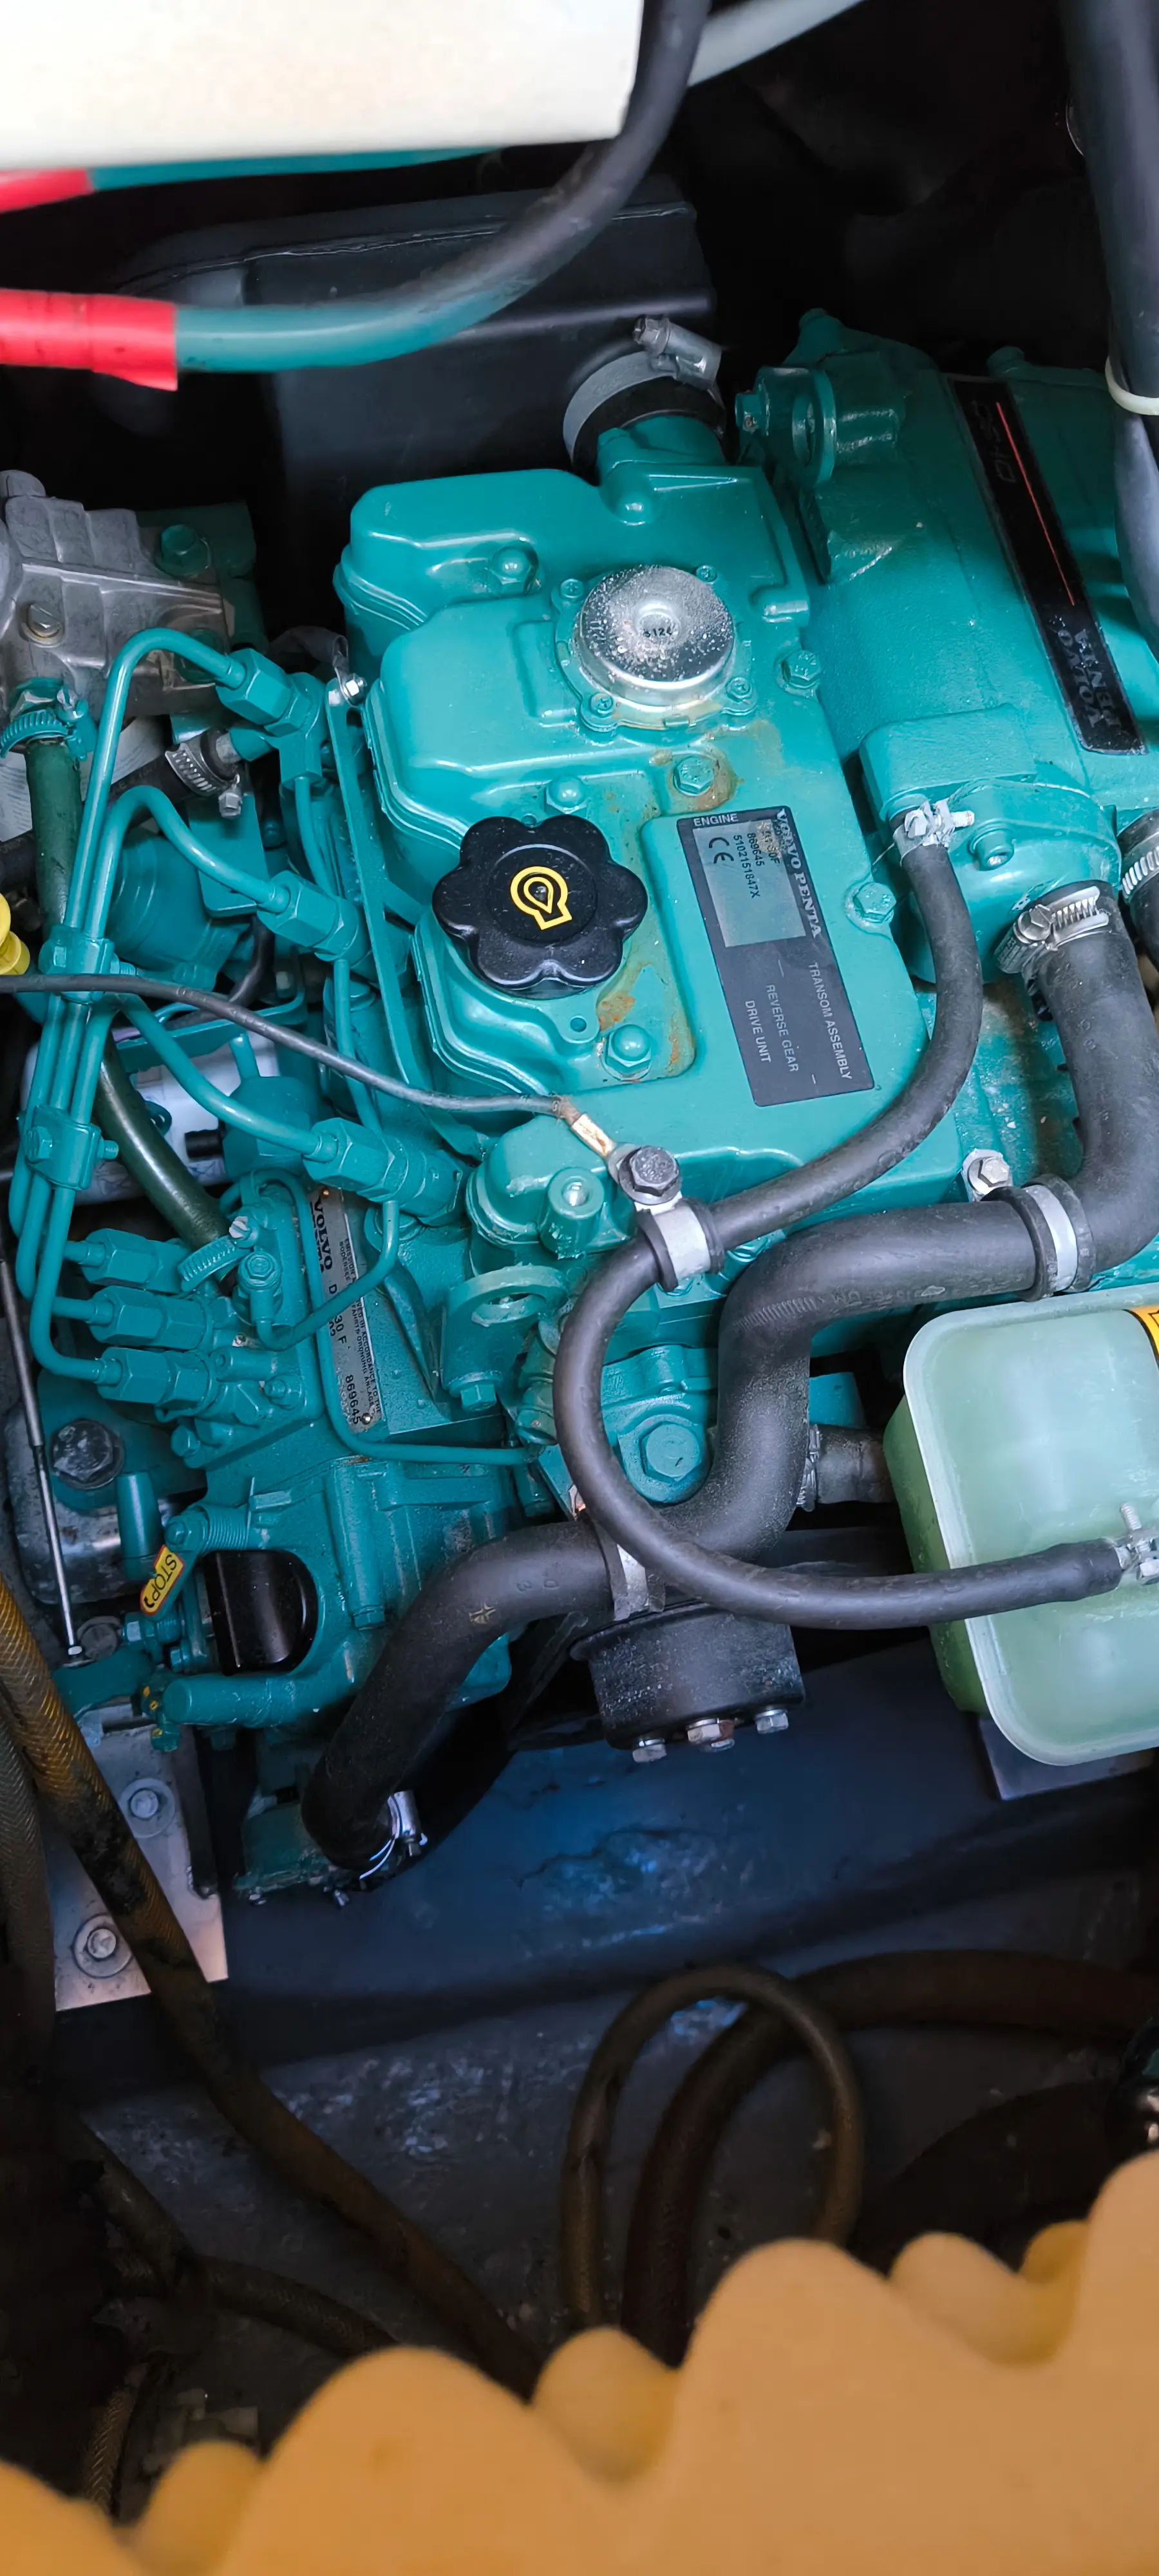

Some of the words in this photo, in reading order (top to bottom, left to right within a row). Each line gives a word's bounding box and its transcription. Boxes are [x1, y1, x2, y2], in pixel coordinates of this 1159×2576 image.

[1058, 630, 1101, 728] VOLVO
[693, 813, 739, 827] ENGINE
[733, 835, 760, 898] 5102151847X
[777, 808, 801, 869] VOLVO
[794, 872, 822, 938] PENTA
[746, 1000, 763, 1034] DRIVE
[755, 1036, 771, 1063] UNIT
[766, 985, 789, 1037] REVERSE
[782, 1039, 798, 1072] GEAR
[808, 962, 833, 1018] TRANSOM
[825, 1021, 852, 1079] ASSEMBLY
[314, 1196, 332, 1270] VOLVO
[345, 1374, 362, 1425] 869645
[152, 1555, 176, 1602] STOP
